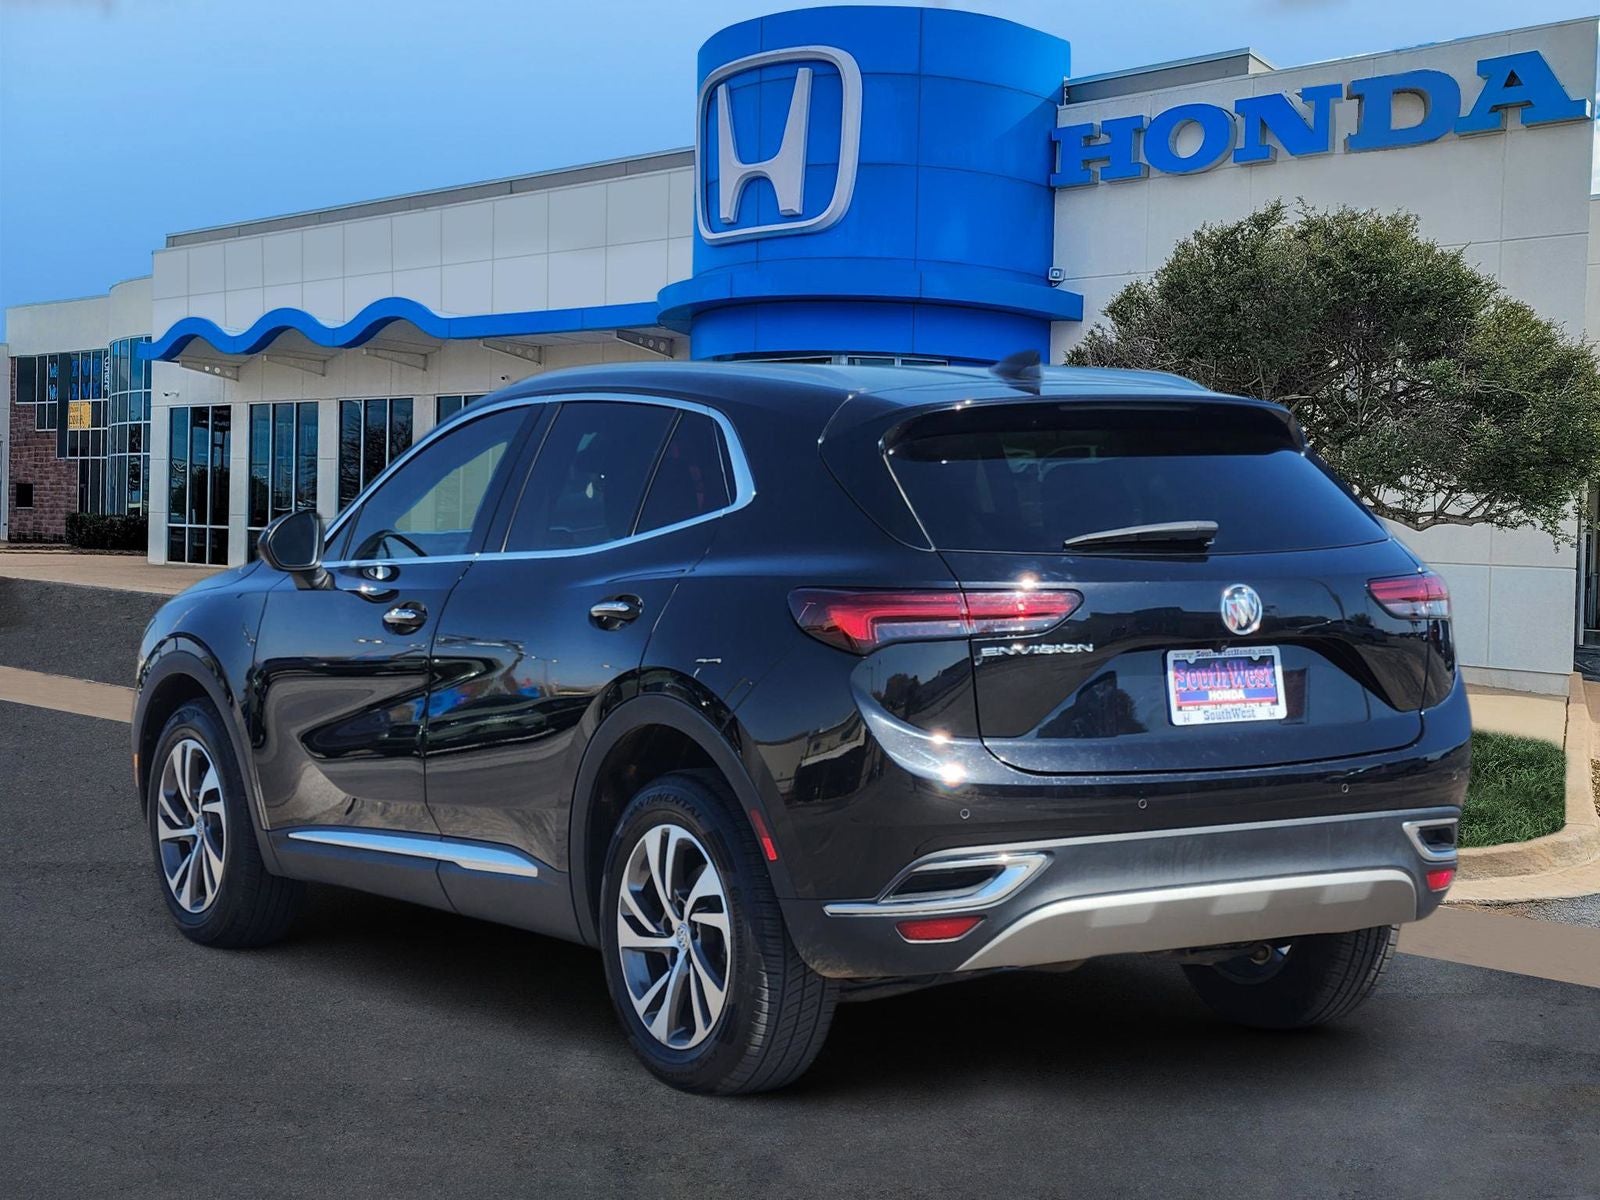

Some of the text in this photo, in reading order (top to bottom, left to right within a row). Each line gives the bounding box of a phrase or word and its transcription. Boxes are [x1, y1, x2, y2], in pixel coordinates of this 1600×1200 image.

[1050, 50, 1591, 188] HONDA
[981, 643, 1094, 657] ENVISION
[1208, 689, 1246, 701] HONDA
[1203, 708, 1257, 721] SouthWest
